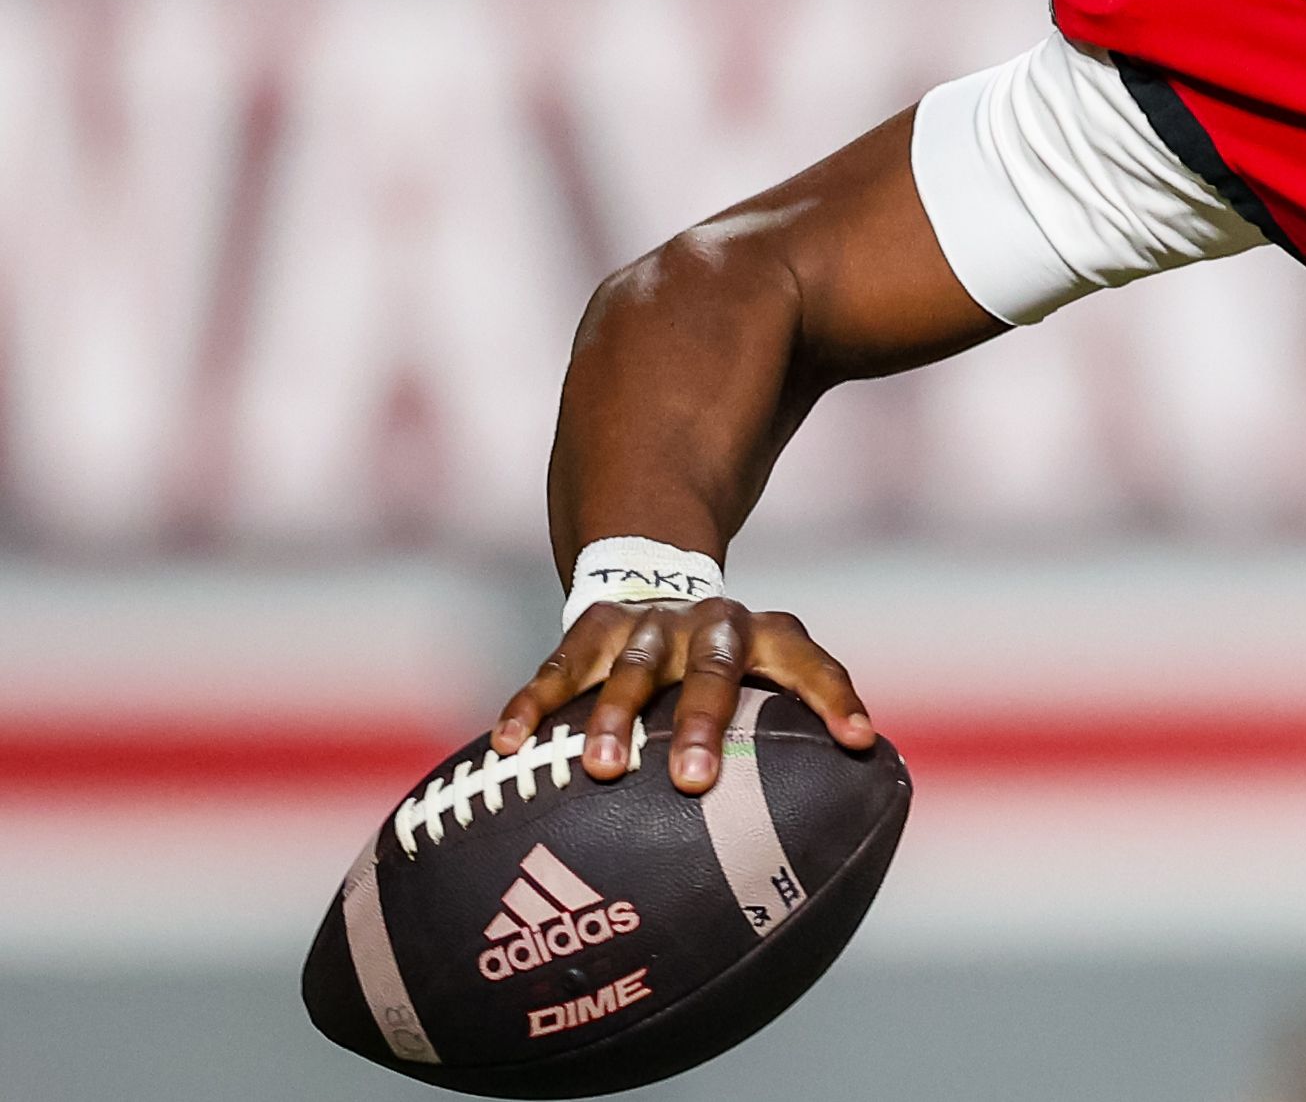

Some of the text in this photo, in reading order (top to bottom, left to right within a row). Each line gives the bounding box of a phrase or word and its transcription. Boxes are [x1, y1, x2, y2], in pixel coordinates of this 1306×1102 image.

[587, 569, 712, 598] TAKE
[478, 901, 642, 981] adidas
[527, 967, 653, 1038] DIME
